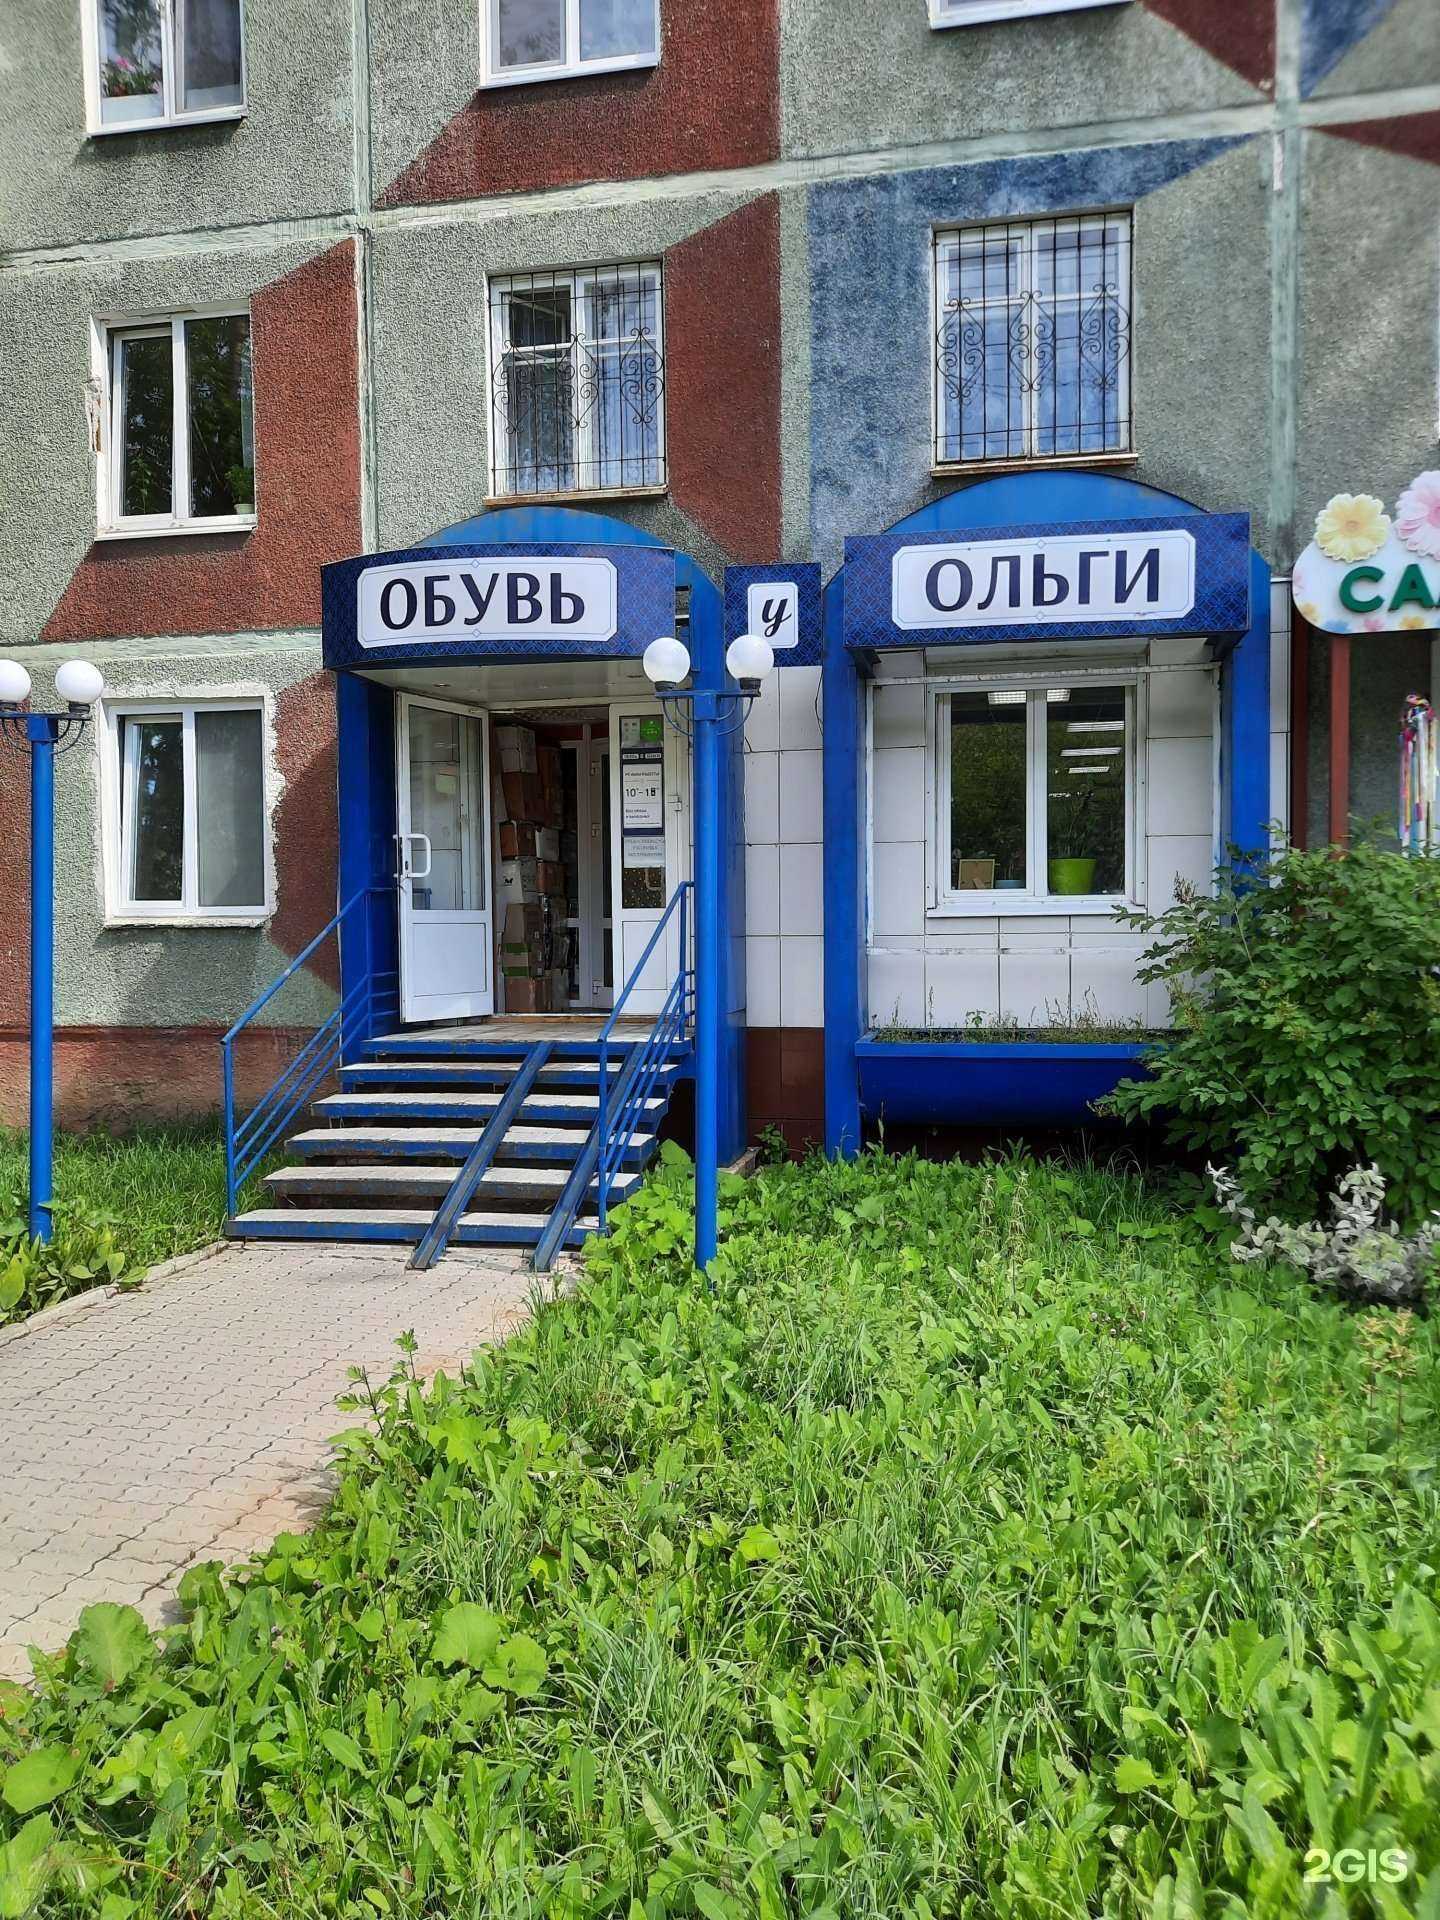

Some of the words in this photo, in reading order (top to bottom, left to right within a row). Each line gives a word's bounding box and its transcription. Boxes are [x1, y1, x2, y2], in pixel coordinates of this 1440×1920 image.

[380, 572, 585, 631] ОБУВЬ
[925, 548, 1160, 612] ОЛЬГИ
[1339, 563, 1440, 613] СА
